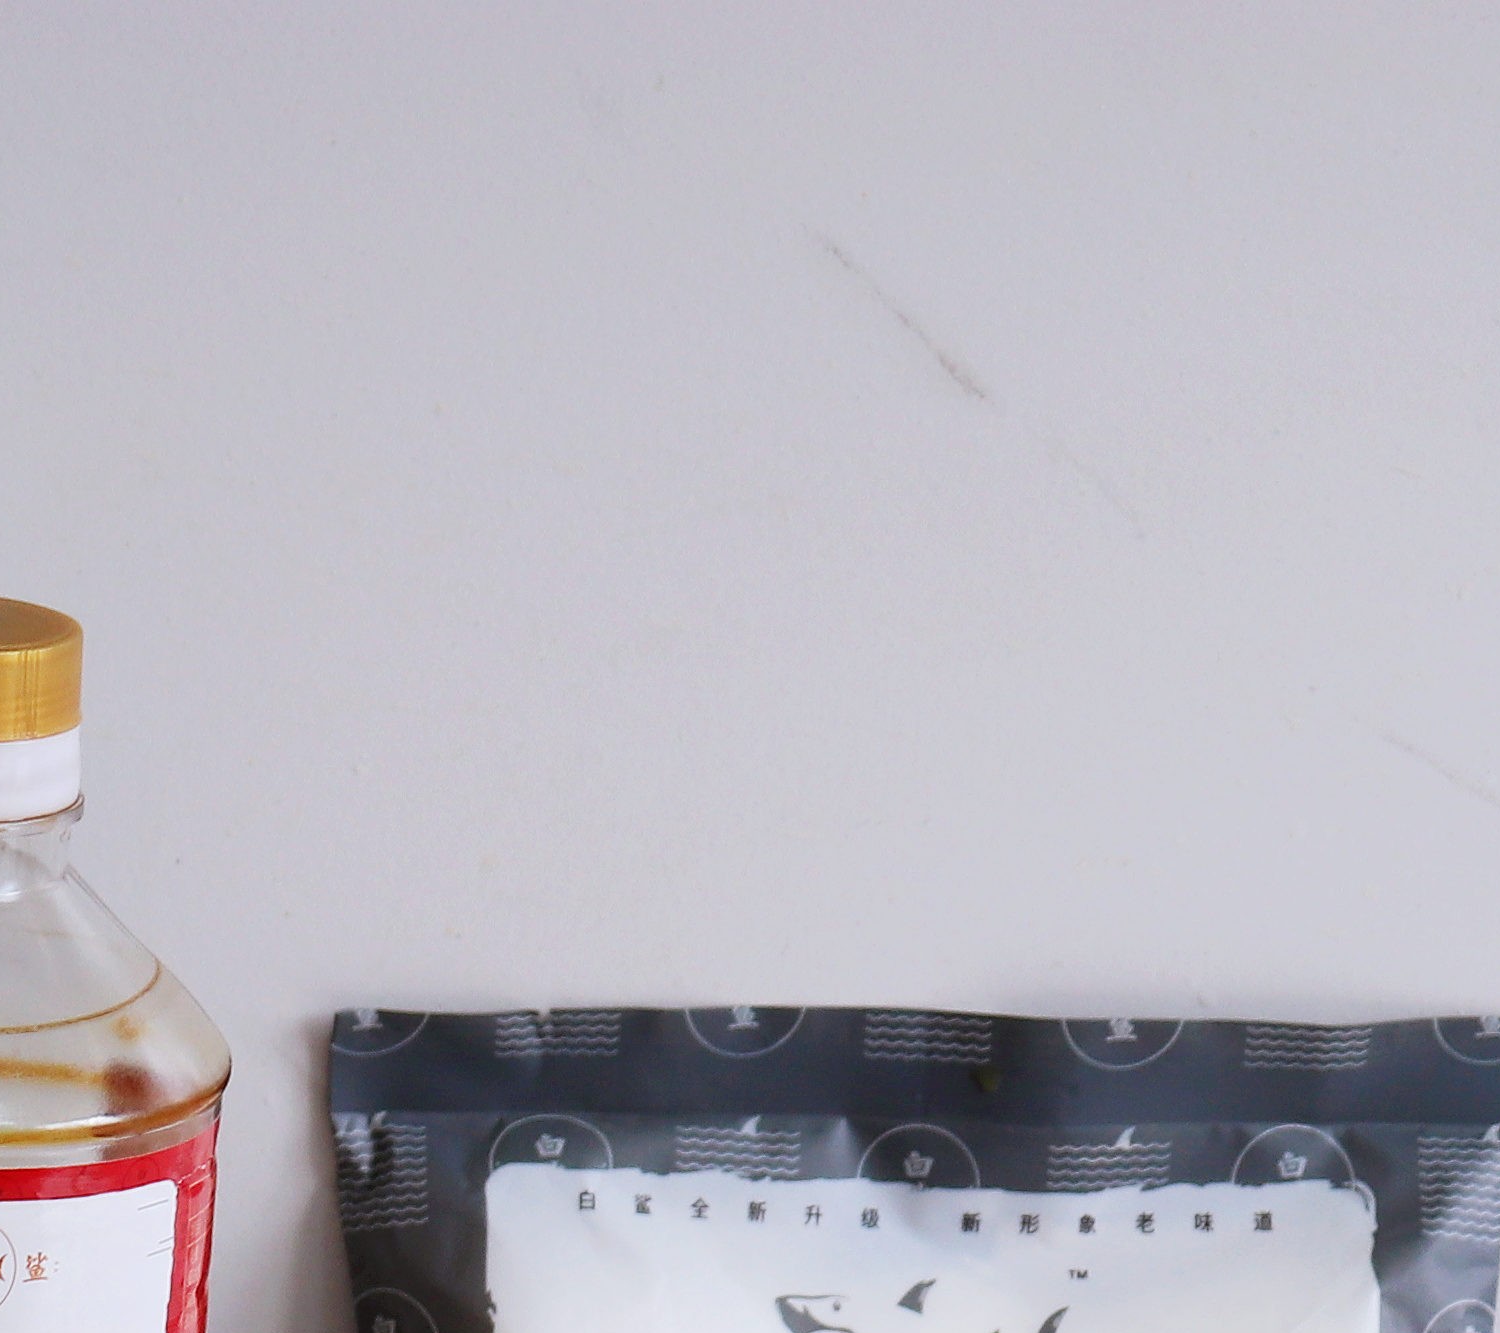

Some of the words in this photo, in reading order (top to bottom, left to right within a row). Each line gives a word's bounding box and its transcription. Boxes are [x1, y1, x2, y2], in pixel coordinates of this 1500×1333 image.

[577, 1190, 881, 1231] 白鲨全新升级
[960, 1211, 1274, 1234] 新形象老味道
[22, 1251, 49, 1283] 鲨
